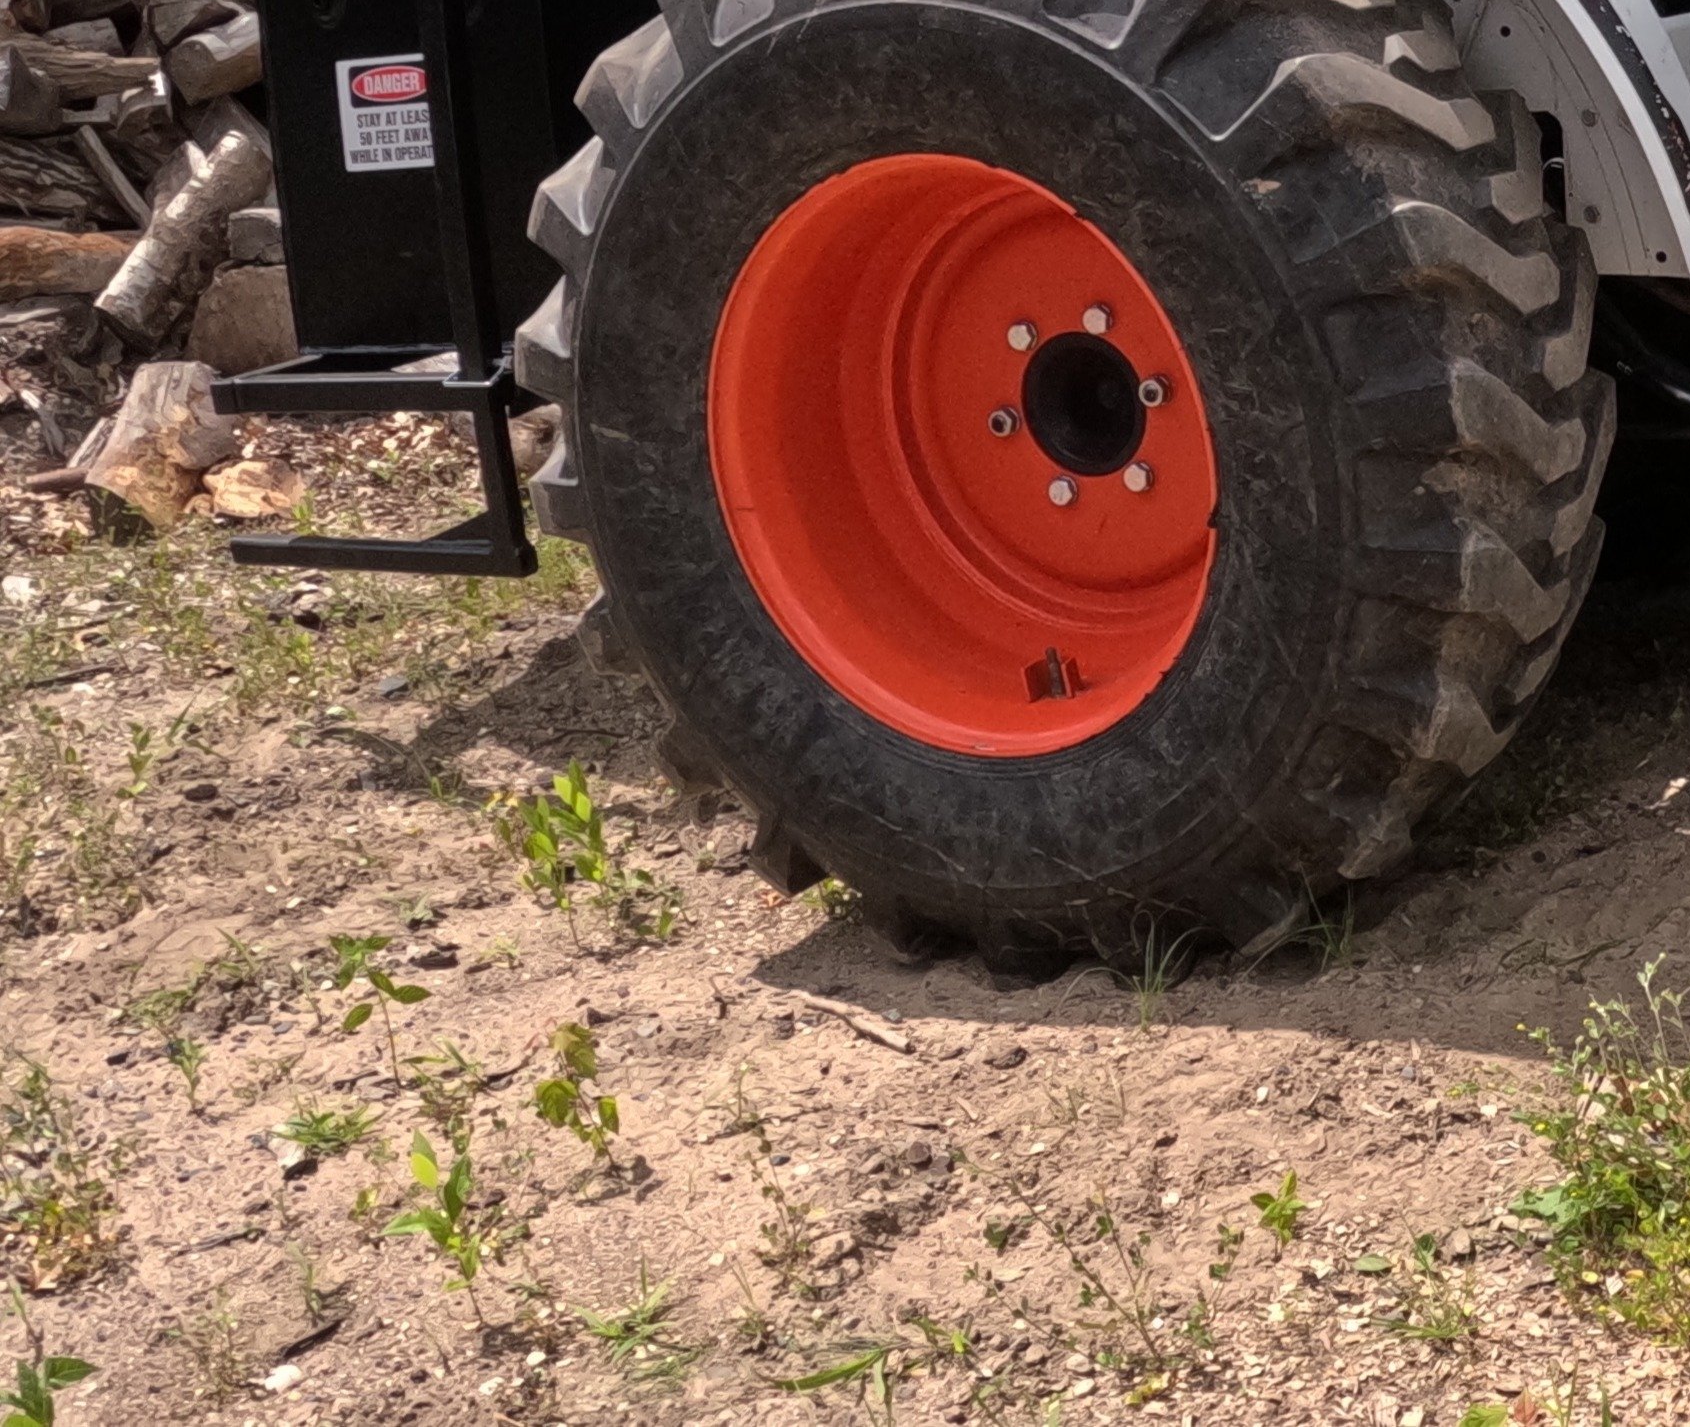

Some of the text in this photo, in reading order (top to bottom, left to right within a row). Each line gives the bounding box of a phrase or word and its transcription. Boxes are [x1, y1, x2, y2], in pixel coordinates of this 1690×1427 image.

[363, 73, 420, 94] DANGER
[357, 109, 430, 128] STAY AT LEAS
[360, 127, 430, 146] 50 FEET AWA
[349, 145, 433, 164] WHILE IN OPERAT
